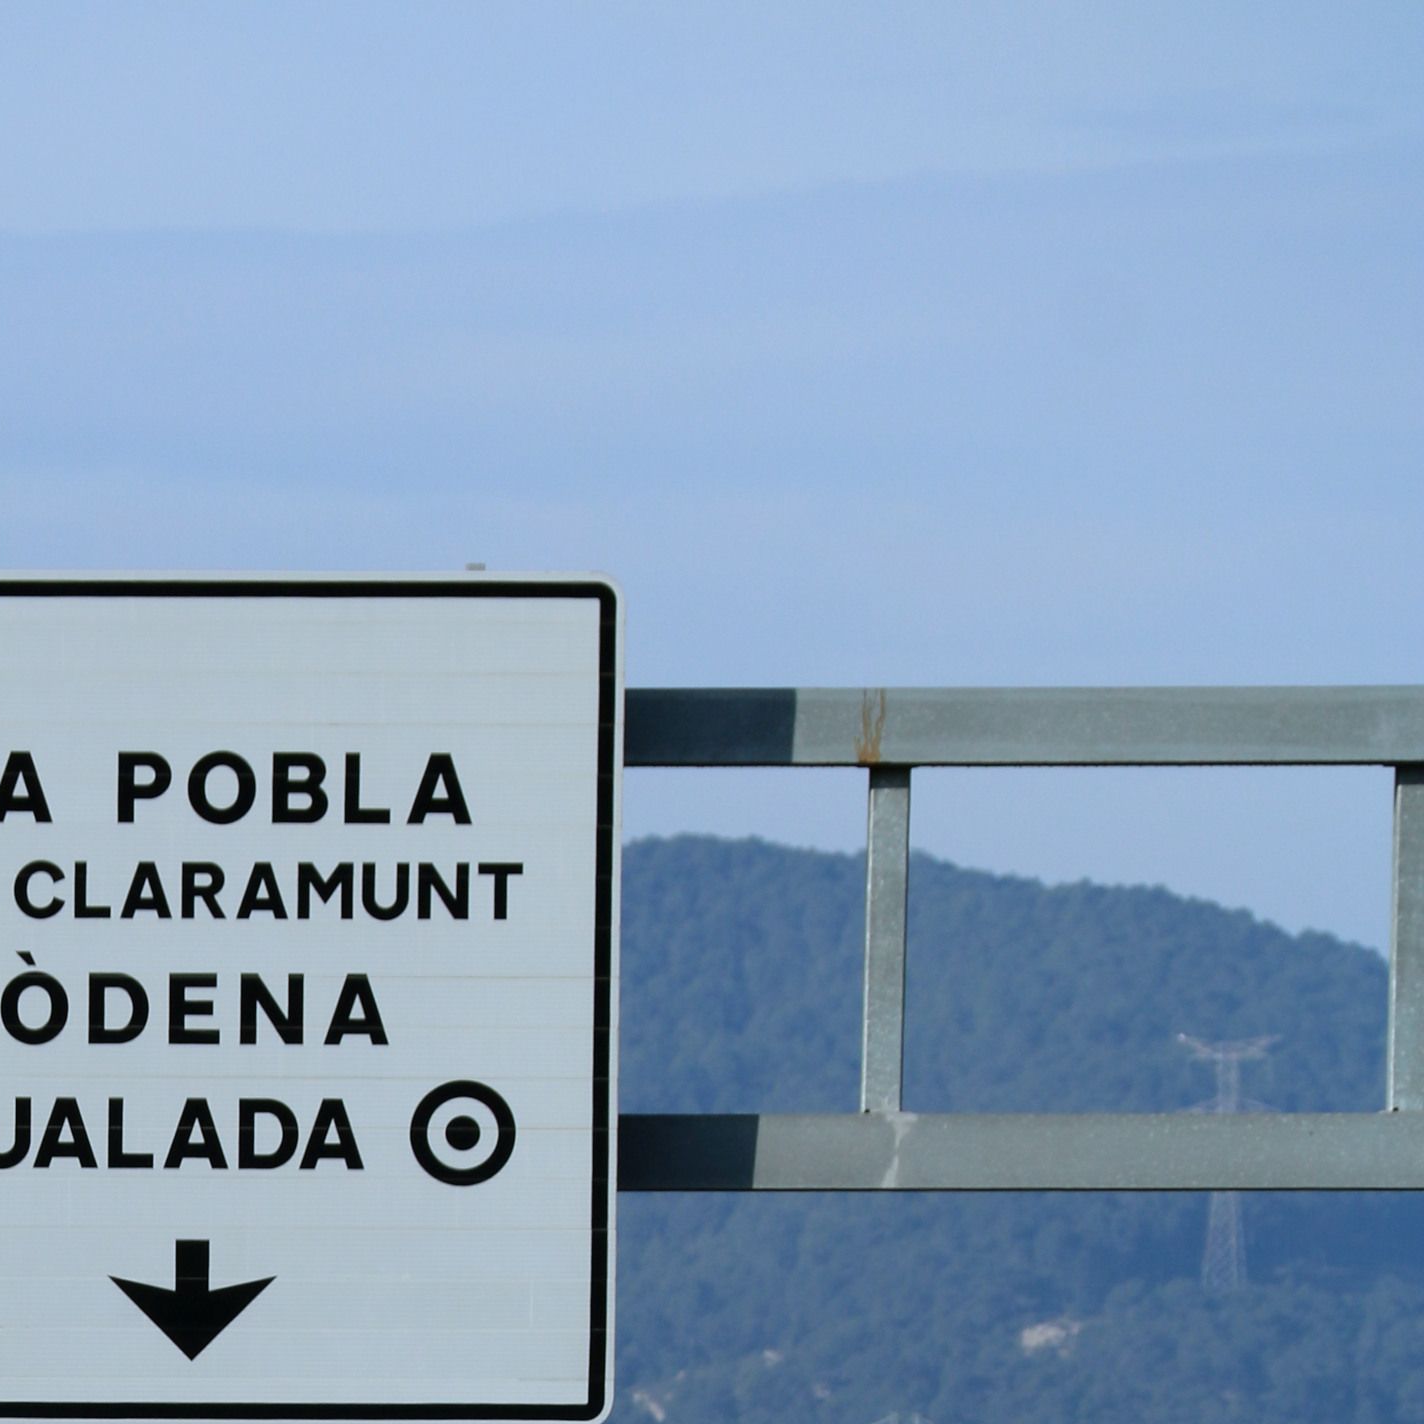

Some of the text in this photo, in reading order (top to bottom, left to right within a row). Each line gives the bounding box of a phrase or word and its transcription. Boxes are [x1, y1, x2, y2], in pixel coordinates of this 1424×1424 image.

[117, 750, 472, 825] POBLA
[14, 860, 523, 920] CLARAMUNT
[0, 951, 388, 1045] ÒDENA
